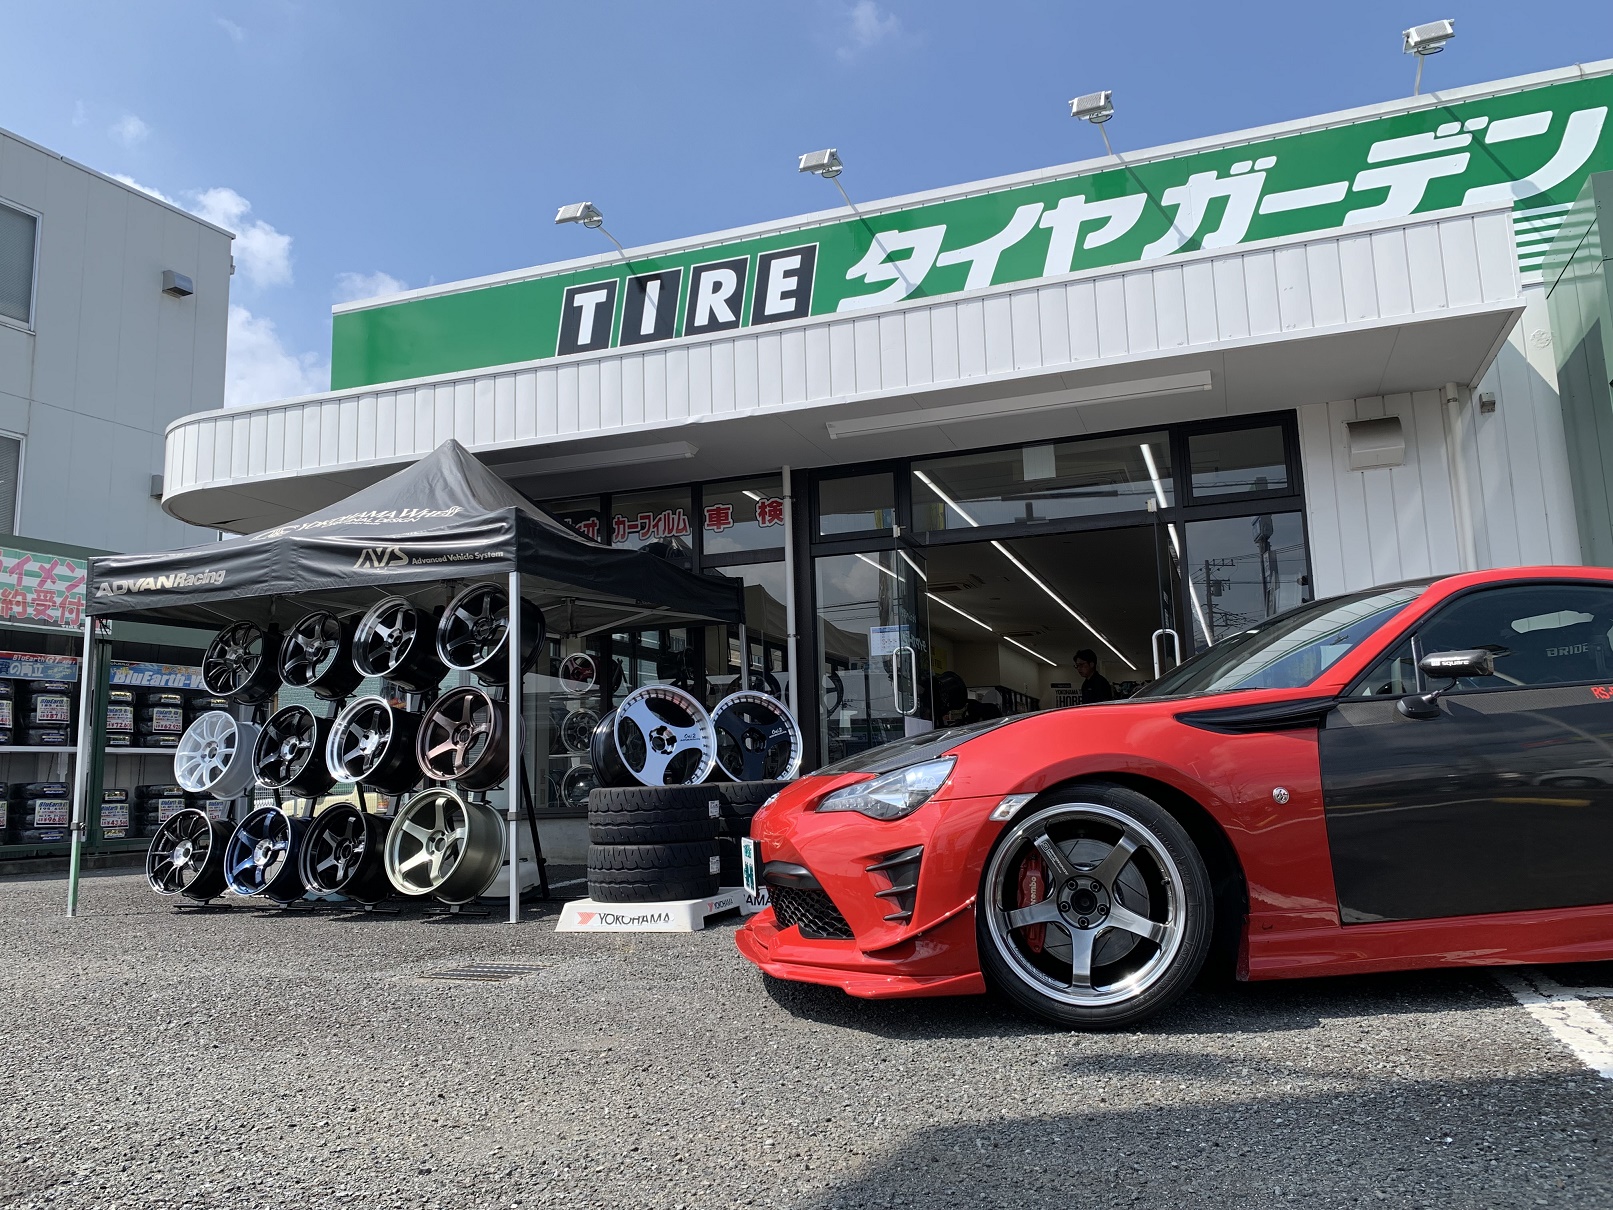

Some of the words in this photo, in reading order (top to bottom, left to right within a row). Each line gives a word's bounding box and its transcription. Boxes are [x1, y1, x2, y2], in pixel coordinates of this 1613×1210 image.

[836, 106, 1608, 312] タイヤガーデン
[573, 255, 801, 346] TIRE
[613, 509, 692, 543] カーフィルム
[0, 549, 86, 594] イメン
[412, 556, 447, 565] Advanced
[449, 552, 474, 561] Vehicle
[475, 550, 504, 559] System
[1545, 642, 1589, 657] BRIDE
